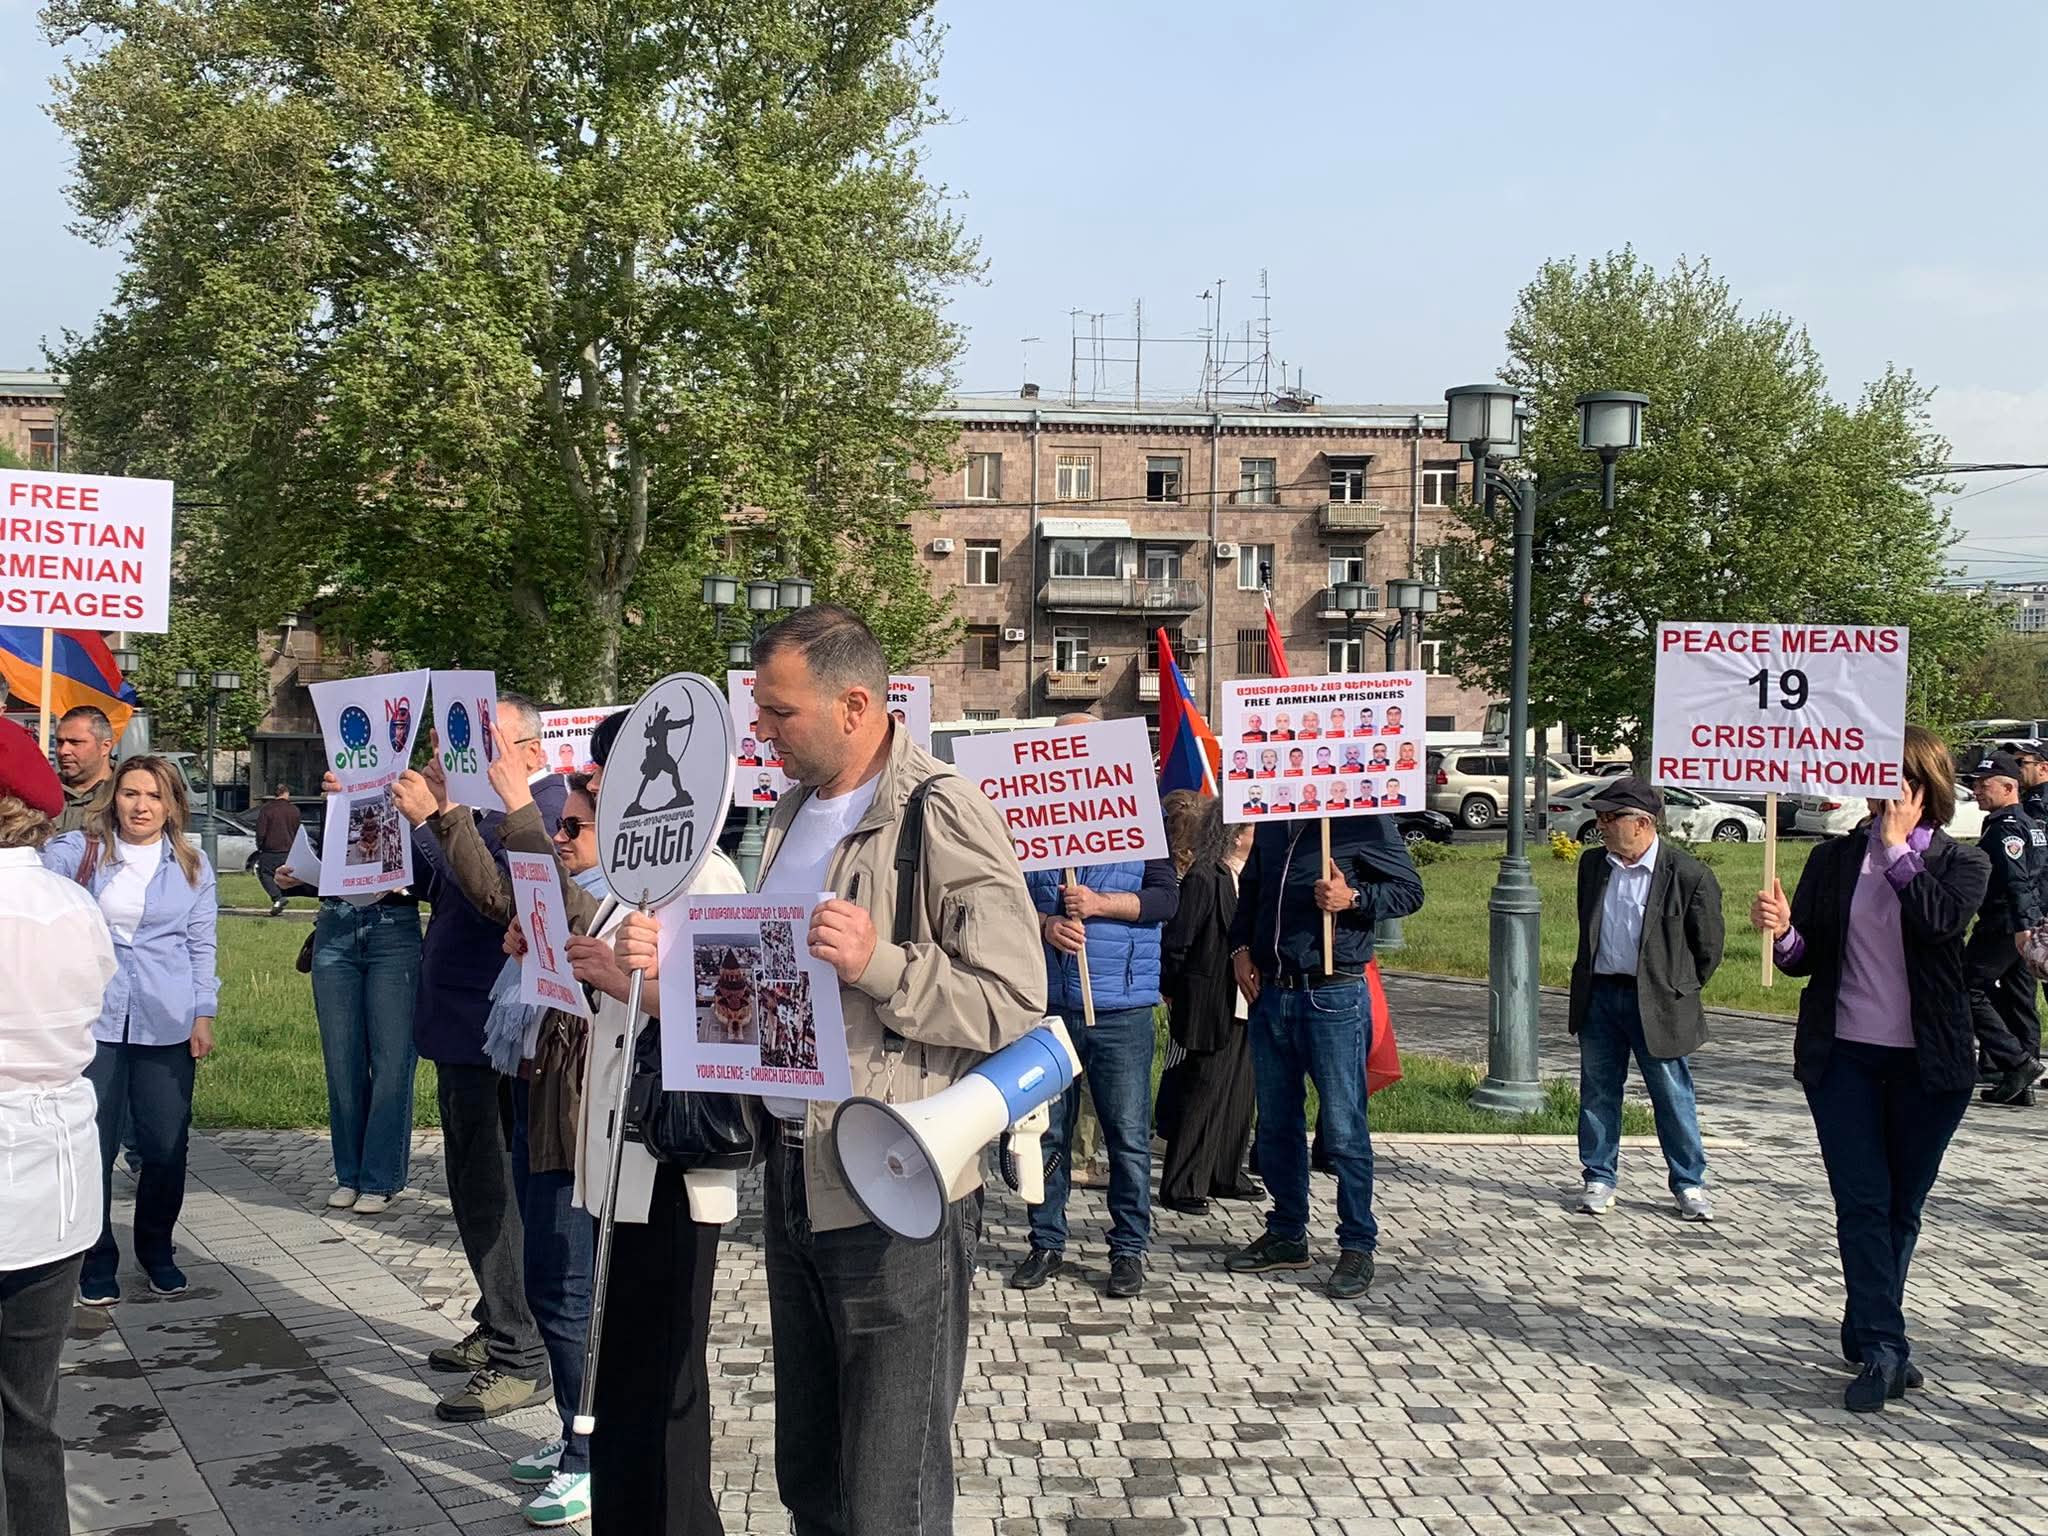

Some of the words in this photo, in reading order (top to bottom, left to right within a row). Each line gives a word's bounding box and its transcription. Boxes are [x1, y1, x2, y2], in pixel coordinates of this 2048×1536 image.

[9, 483, 99, 511] FREE
[0, 517, 145, 549] RISTIAN
[0, 553, 142, 584] MENIAN
[0, 588, 144, 619] STAGES
[1663, 629, 1770, 653] PEACE
[1782, 629, 1899, 653] MEANS
[1237, 684, 1318, 696] ԱԶԱՏՈՒԹՅՈՒՆ
[1320, 682, 1342, 691] ՀԱՅ
[1344, 678, 1413, 690] ԳԵՐԻՆԵՐԻՆ
[1244, 698, 1271, 707] FREE
[1276, 694, 1336, 705] ARMENIAN
[1339, 690, 1405, 701] PRISONERS
[1749, 668, 1809, 710] 19
[385, 697, 410, 722] NO
[1013, 735, 1089, 764] FREE
[1691, 725, 1865, 751] CRISTIANS
[344, 744, 378, 769] YES
[450, 746, 477, 774] YES
[979, 763, 1134, 800] CHRISTIAN
[1659, 757, 1789, 782] RETURN
[1801, 761, 1898, 786] HOME
[1005, 795, 1138, 830] RMENIAN
[611, 821, 694, 873] ԲԵՎԵՌ
[1014, 827, 1145, 861] OSTAGES
[696, 1064, 715, 1079] YOUR
[716, 1065, 744, 1080] SILENCE
[751, 1067, 778, 1082] CHURCH
[779, 1070, 825, 1085] DESTRUCTION
